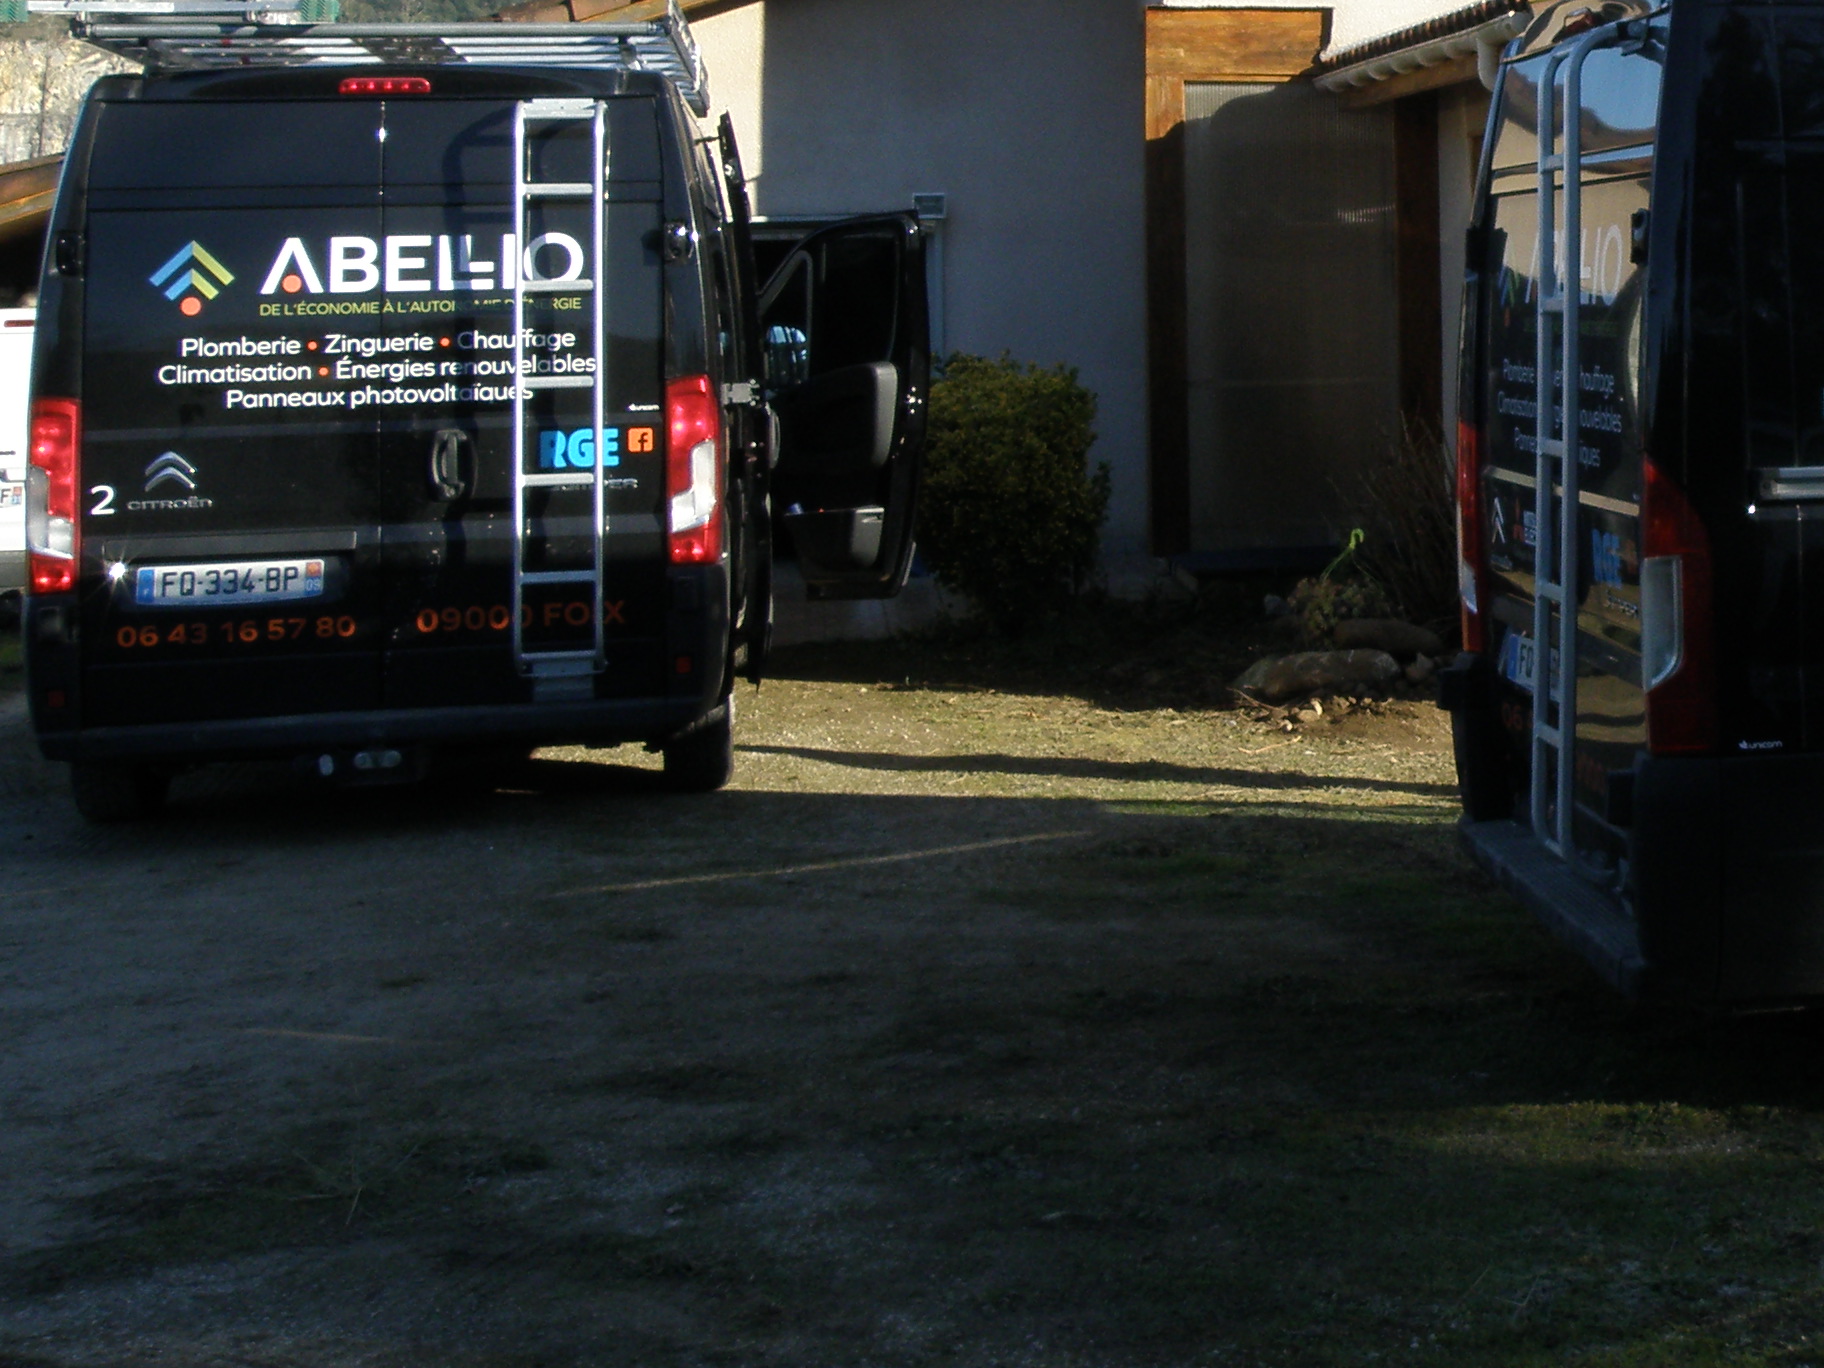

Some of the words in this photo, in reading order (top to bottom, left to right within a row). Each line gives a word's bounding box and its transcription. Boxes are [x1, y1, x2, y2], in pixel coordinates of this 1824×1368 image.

[259, 233, 584, 294] ABELLIO
[259, 303, 281, 317] DE
[284, 300, 380, 316] L'ÉCONOMIE
[382, 298, 395, 314] À
[181, 336, 302, 358] Plomberie
[324, 332, 434, 358] Zinguerie
[458, 328, 576, 352] Chauffage
[158, 363, 312, 385] Climatisation
[336, 356, 435, 382] Énergies
[226, 388, 346, 410] Panneaux
[540, 428, 620, 469] RGE
[90, 485, 116, 516] 2
[162, 567, 300, 598] FQ-334-BP
[117, 625, 159, 648] 06
[167, 623, 207, 645] 43
[220, 620, 259, 643] 16
[267, 618, 306, 641] 57
[316, 615, 357, 638] 80
[544, 599, 625, 626] FOX
